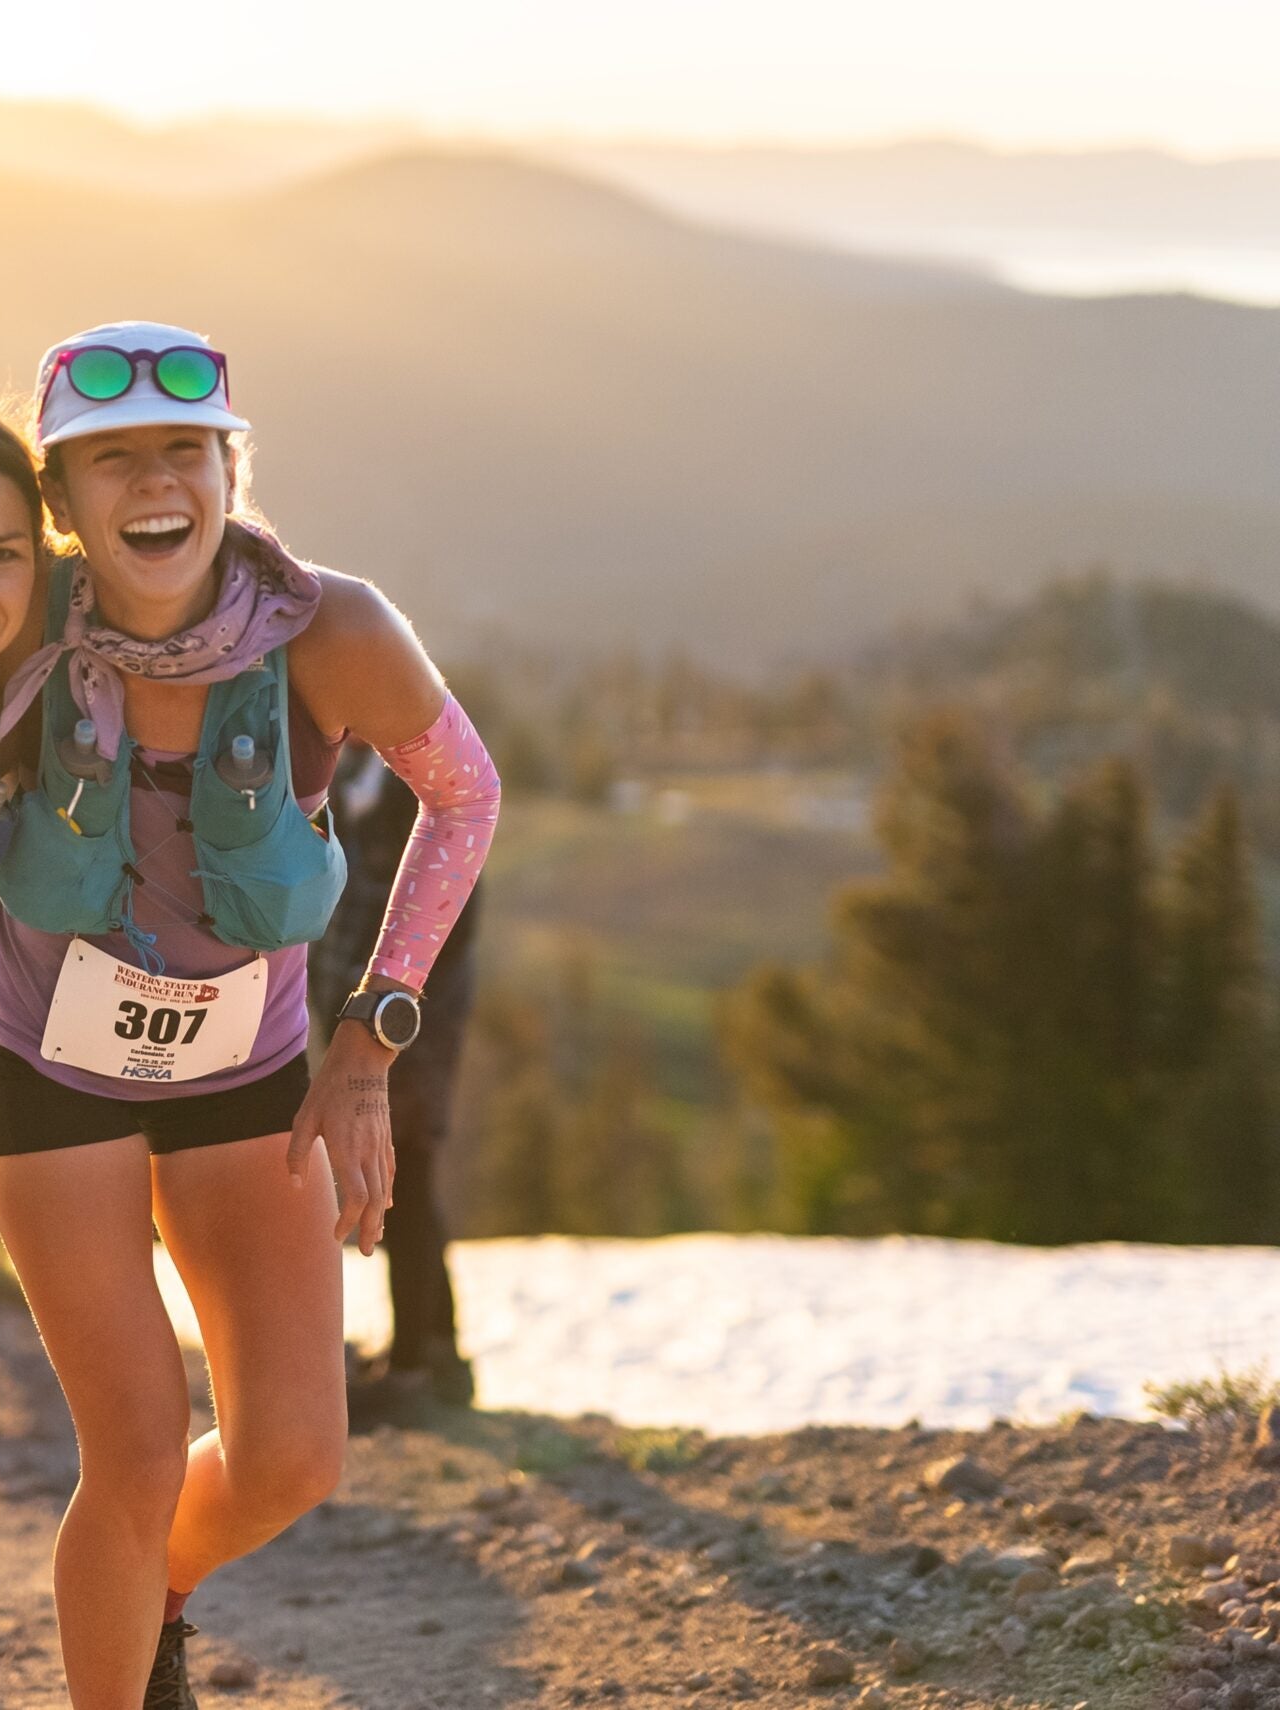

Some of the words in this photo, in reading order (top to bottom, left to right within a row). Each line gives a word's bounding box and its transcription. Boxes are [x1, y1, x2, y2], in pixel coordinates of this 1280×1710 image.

[114, 974, 171, 996] ENDURANCE
[173, 990, 195, 999] RUN
[117, 965, 161, 986] WESTERN
[164, 981, 199, 991] STATES
[114, 1000, 208, 1045] 307
[120, 1066, 172, 1080] HOKA
